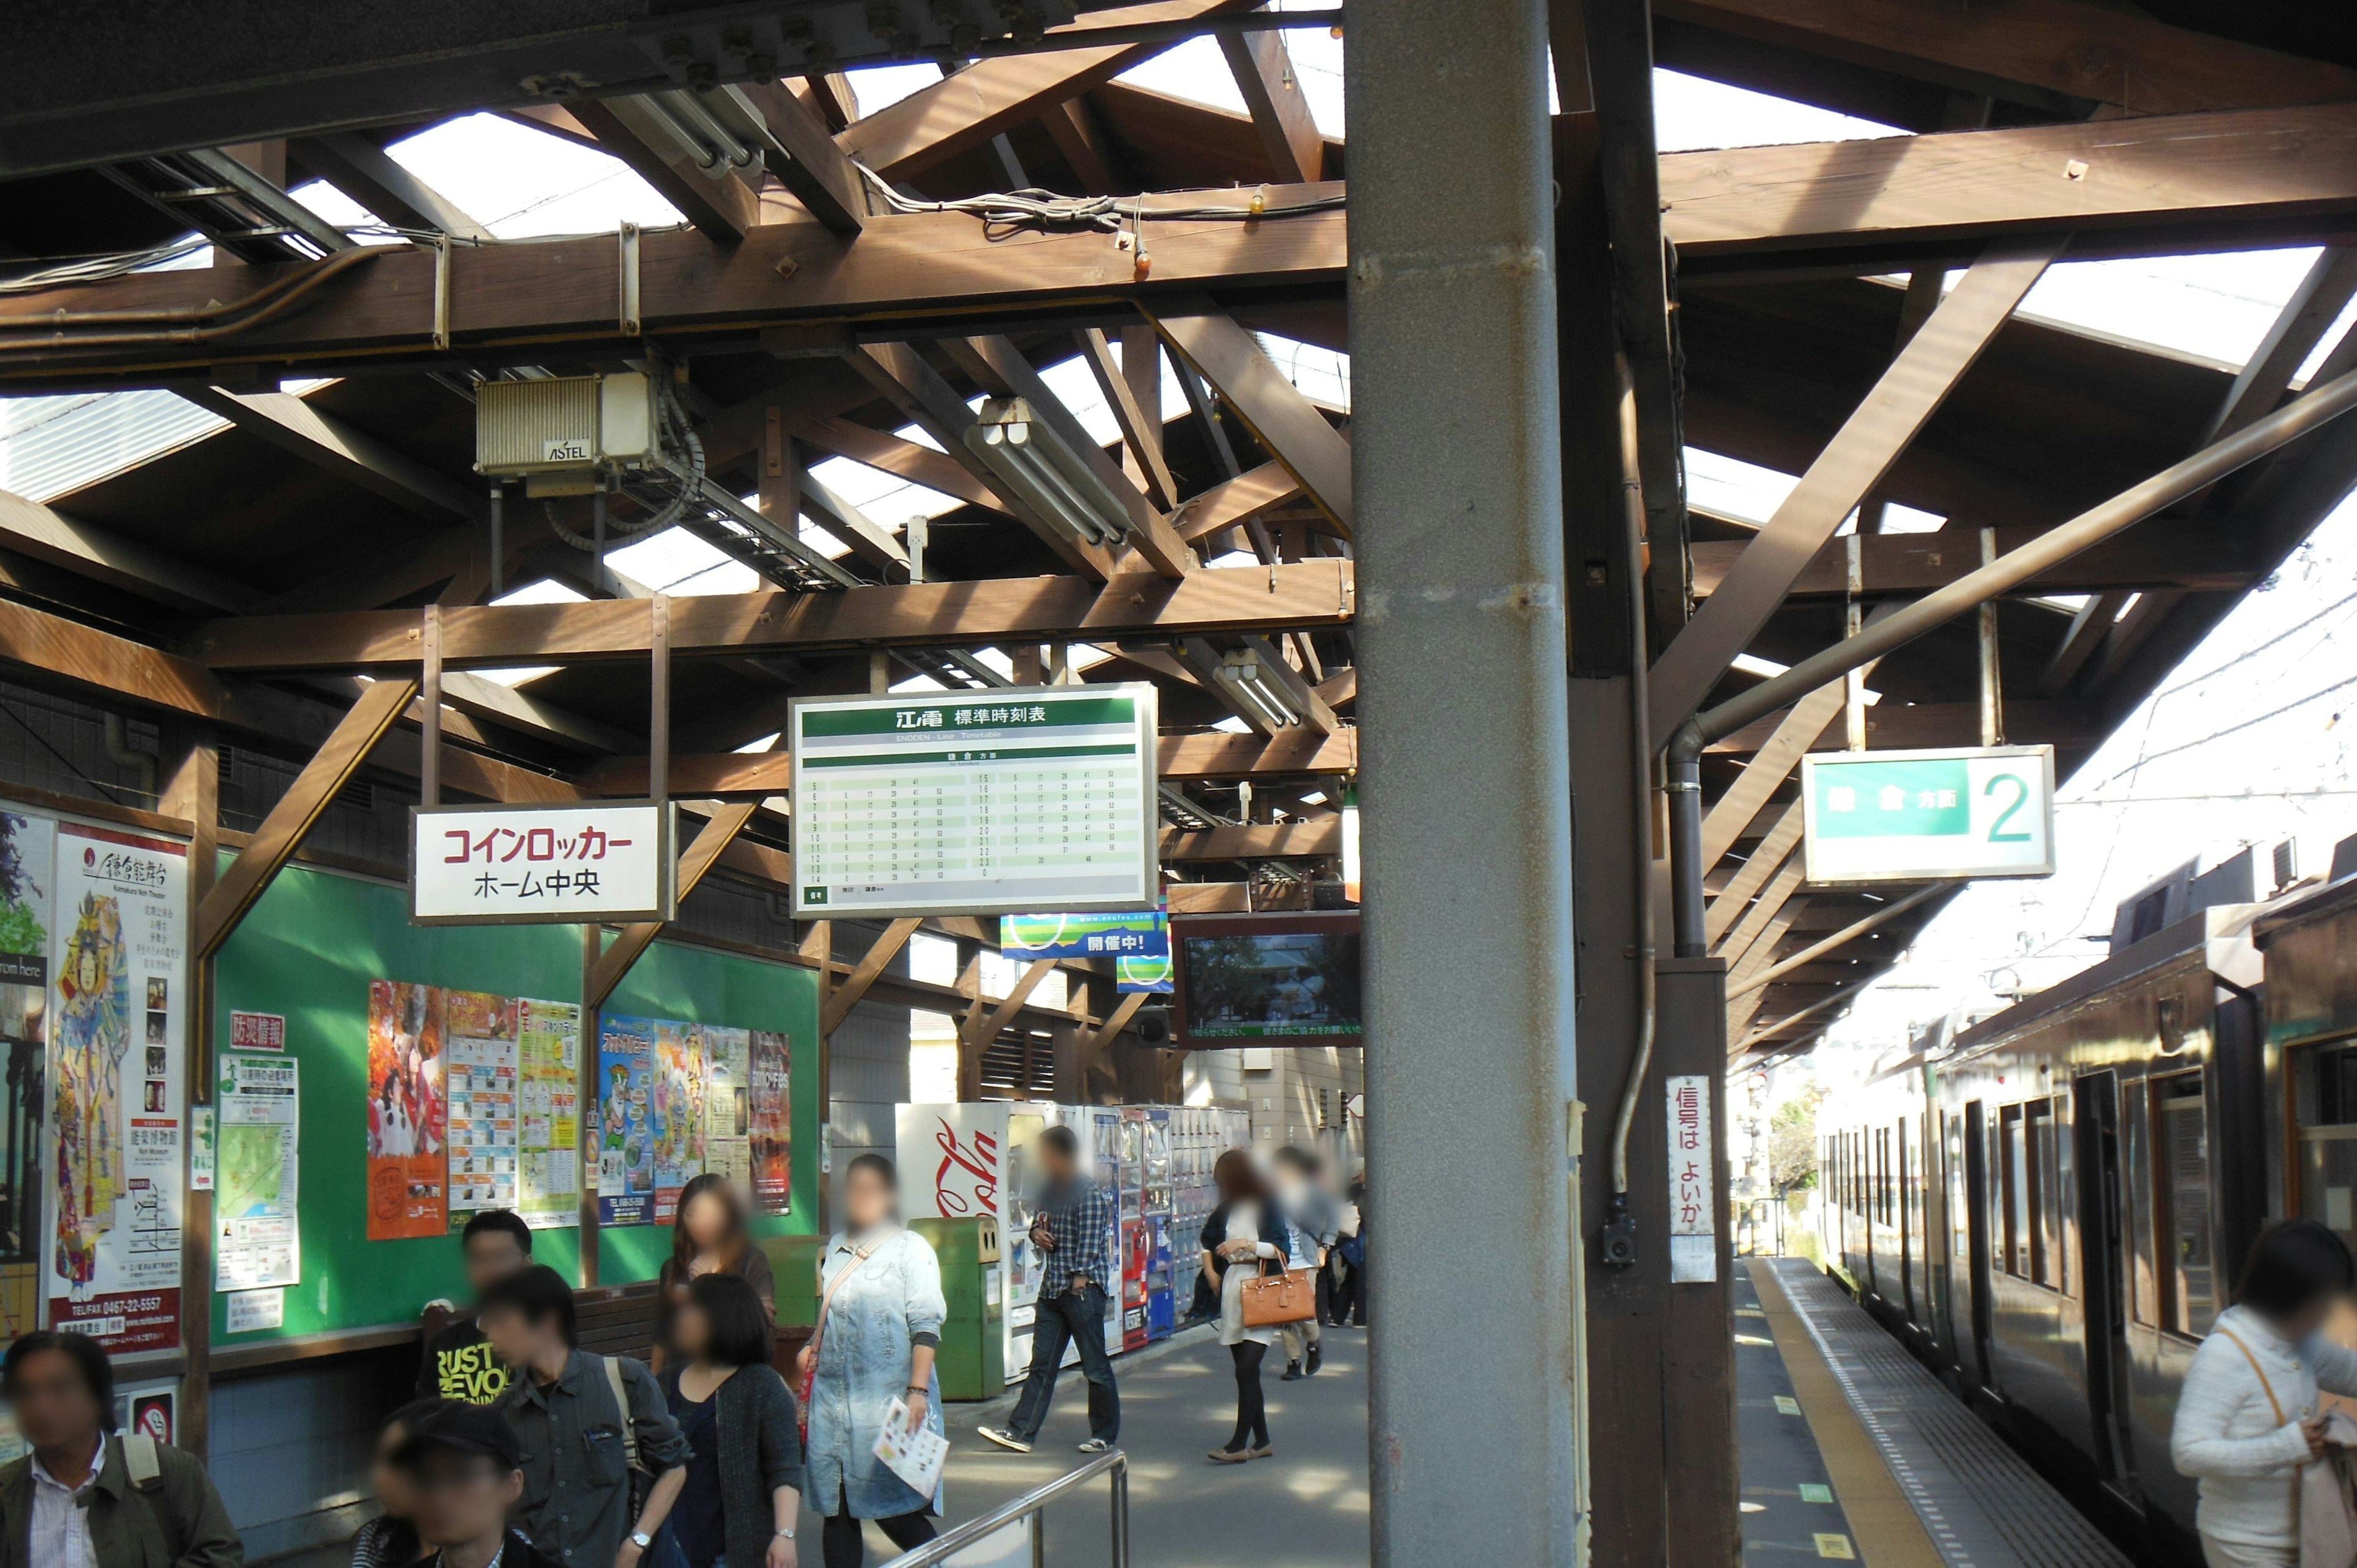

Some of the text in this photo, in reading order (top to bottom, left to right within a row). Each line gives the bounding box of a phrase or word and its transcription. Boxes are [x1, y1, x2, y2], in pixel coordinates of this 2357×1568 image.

[549, 441, 586, 460] ASTEL
[954, 706, 1046, 725] 標準時刻表
[979, 774, 988, 783] 15
[979, 784, 988, 794] 16
[979, 795, 988, 803] 17
[980, 805, 989, 814] 18
[1984, 773, 2032, 843] 2
[980, 816, 989, 824] 19
[979, 826, 989, 835] 20
[811, 833, 820, 842] 10
[979, 836, 988, 846] 21
[444, 825, 632, 863] コインロッカー
[811, 844, 819, 852] 11
[980, 847, 989, 856] 22
[811, 854, 820, 863] 12
[980, 858, 989, 867] 23
[811, 865, 820, 873] 13
[474, 868, 600, 898] ホーム中央
[114, 885, 137, 895] Kamakura
[148, 889, 166, 899] Theater
[1079, 914, 1152, 922] www.enofes.com
[1087, 935, 1144, 952] 開催中!
[0, 956, 41, 977] rom here
[233, 1016, 281, 1045] 防災情報
[1675, 1087, 1700, 1150] 信号は
[1681, 1160, 1703, 1224] よいか
